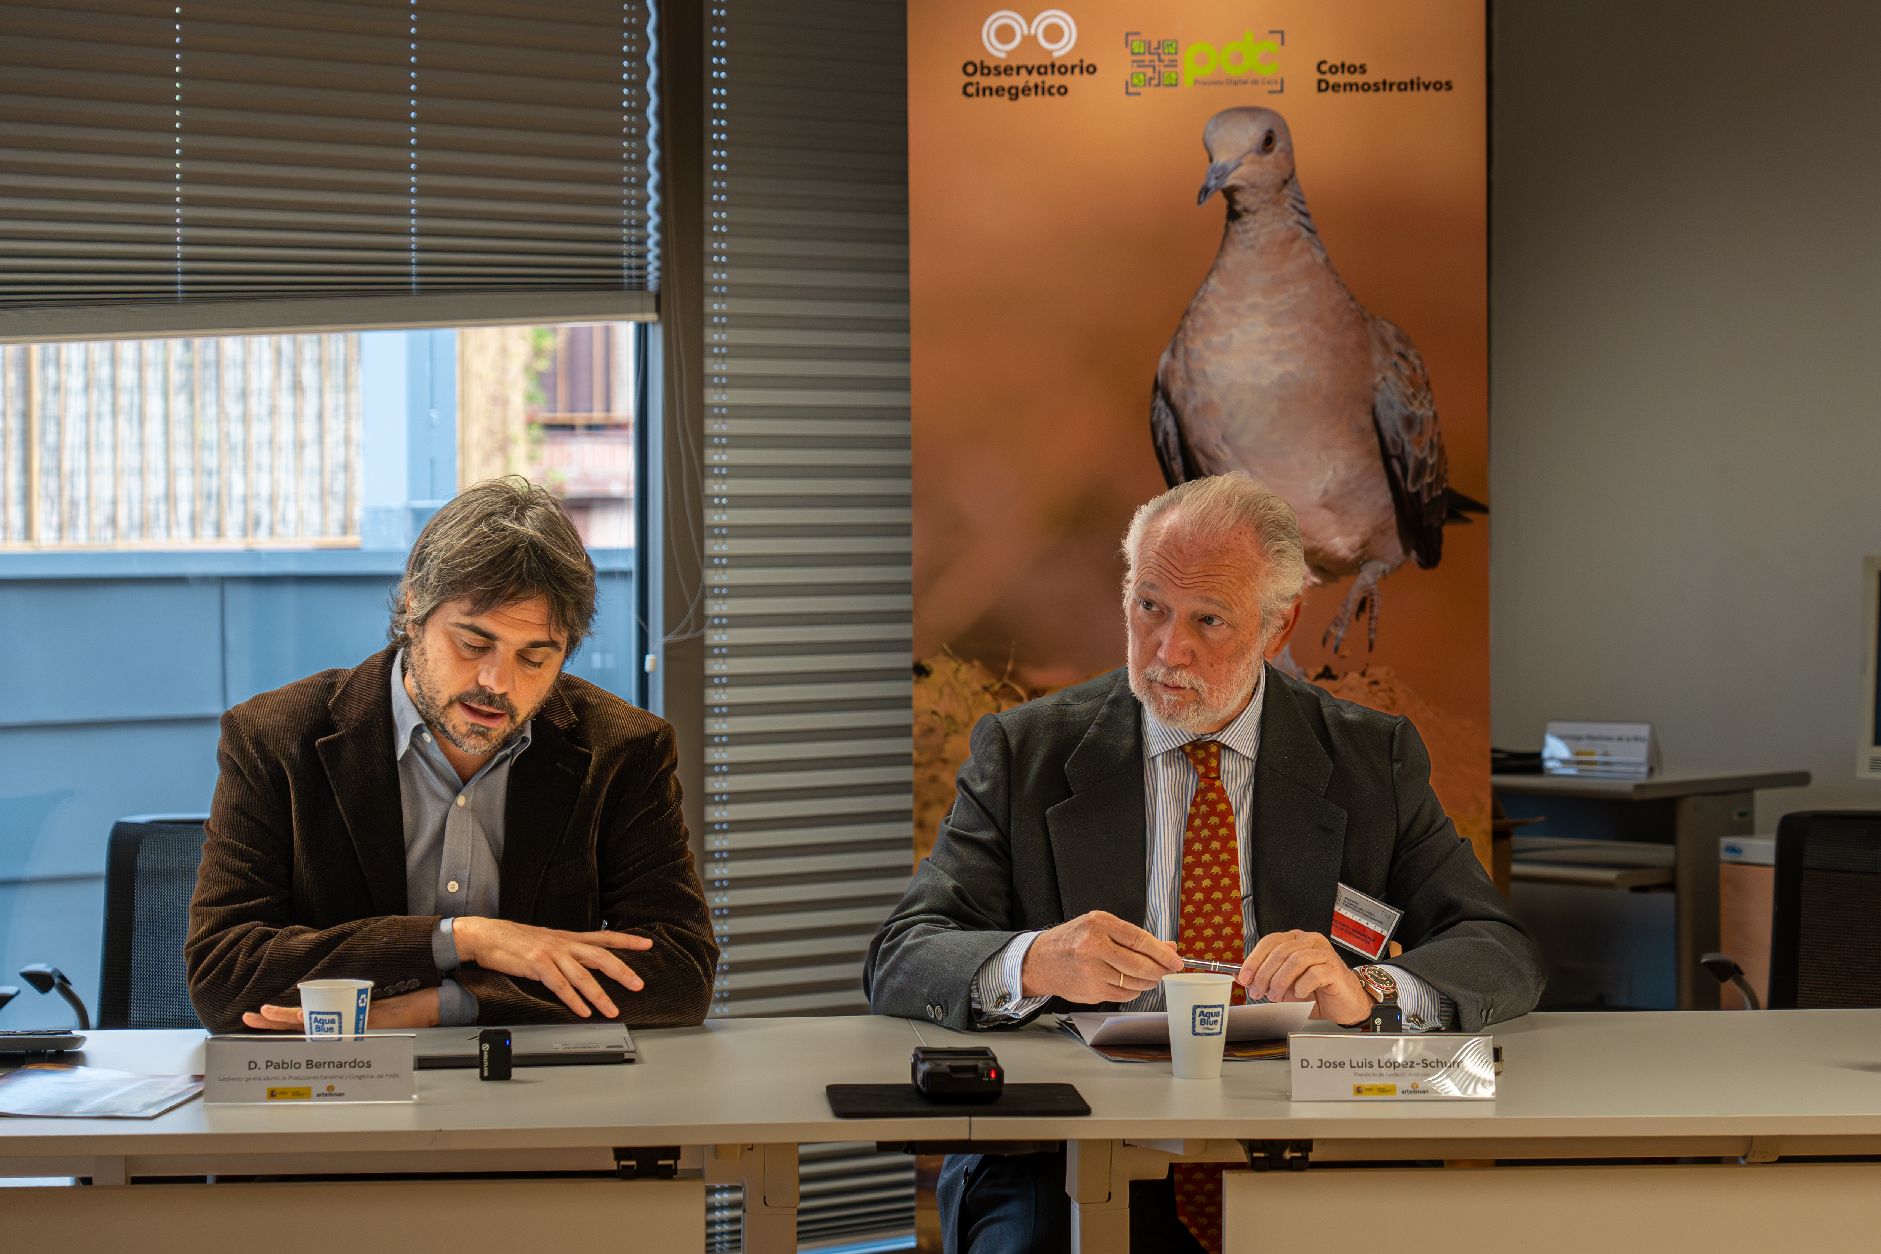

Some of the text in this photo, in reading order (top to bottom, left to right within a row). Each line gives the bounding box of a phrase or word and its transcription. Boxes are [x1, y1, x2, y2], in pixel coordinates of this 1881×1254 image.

[1184, 32, 1279, 88] pdc
[962, 59, 1097, 77] Observatorio
[1316, 60, 1367, 75] Cotos
[962, 80, 1068, 101] Cinegético
[1316, 76, 1454, 93] Demostrativos
[1198, 1010, 1221, 1019] Aqua
[1200, 1018, 1218, 1026] Blue
[315, 1025, 334, 1033] Blue
[248, 1058, 372, 1070] D. Pablo Bernardos
[1300, 1058, 1314, 1069] D.
[1317, 1058, 1346, 1069] Jose
[1349, 1058, 1374, 1069] Luis
